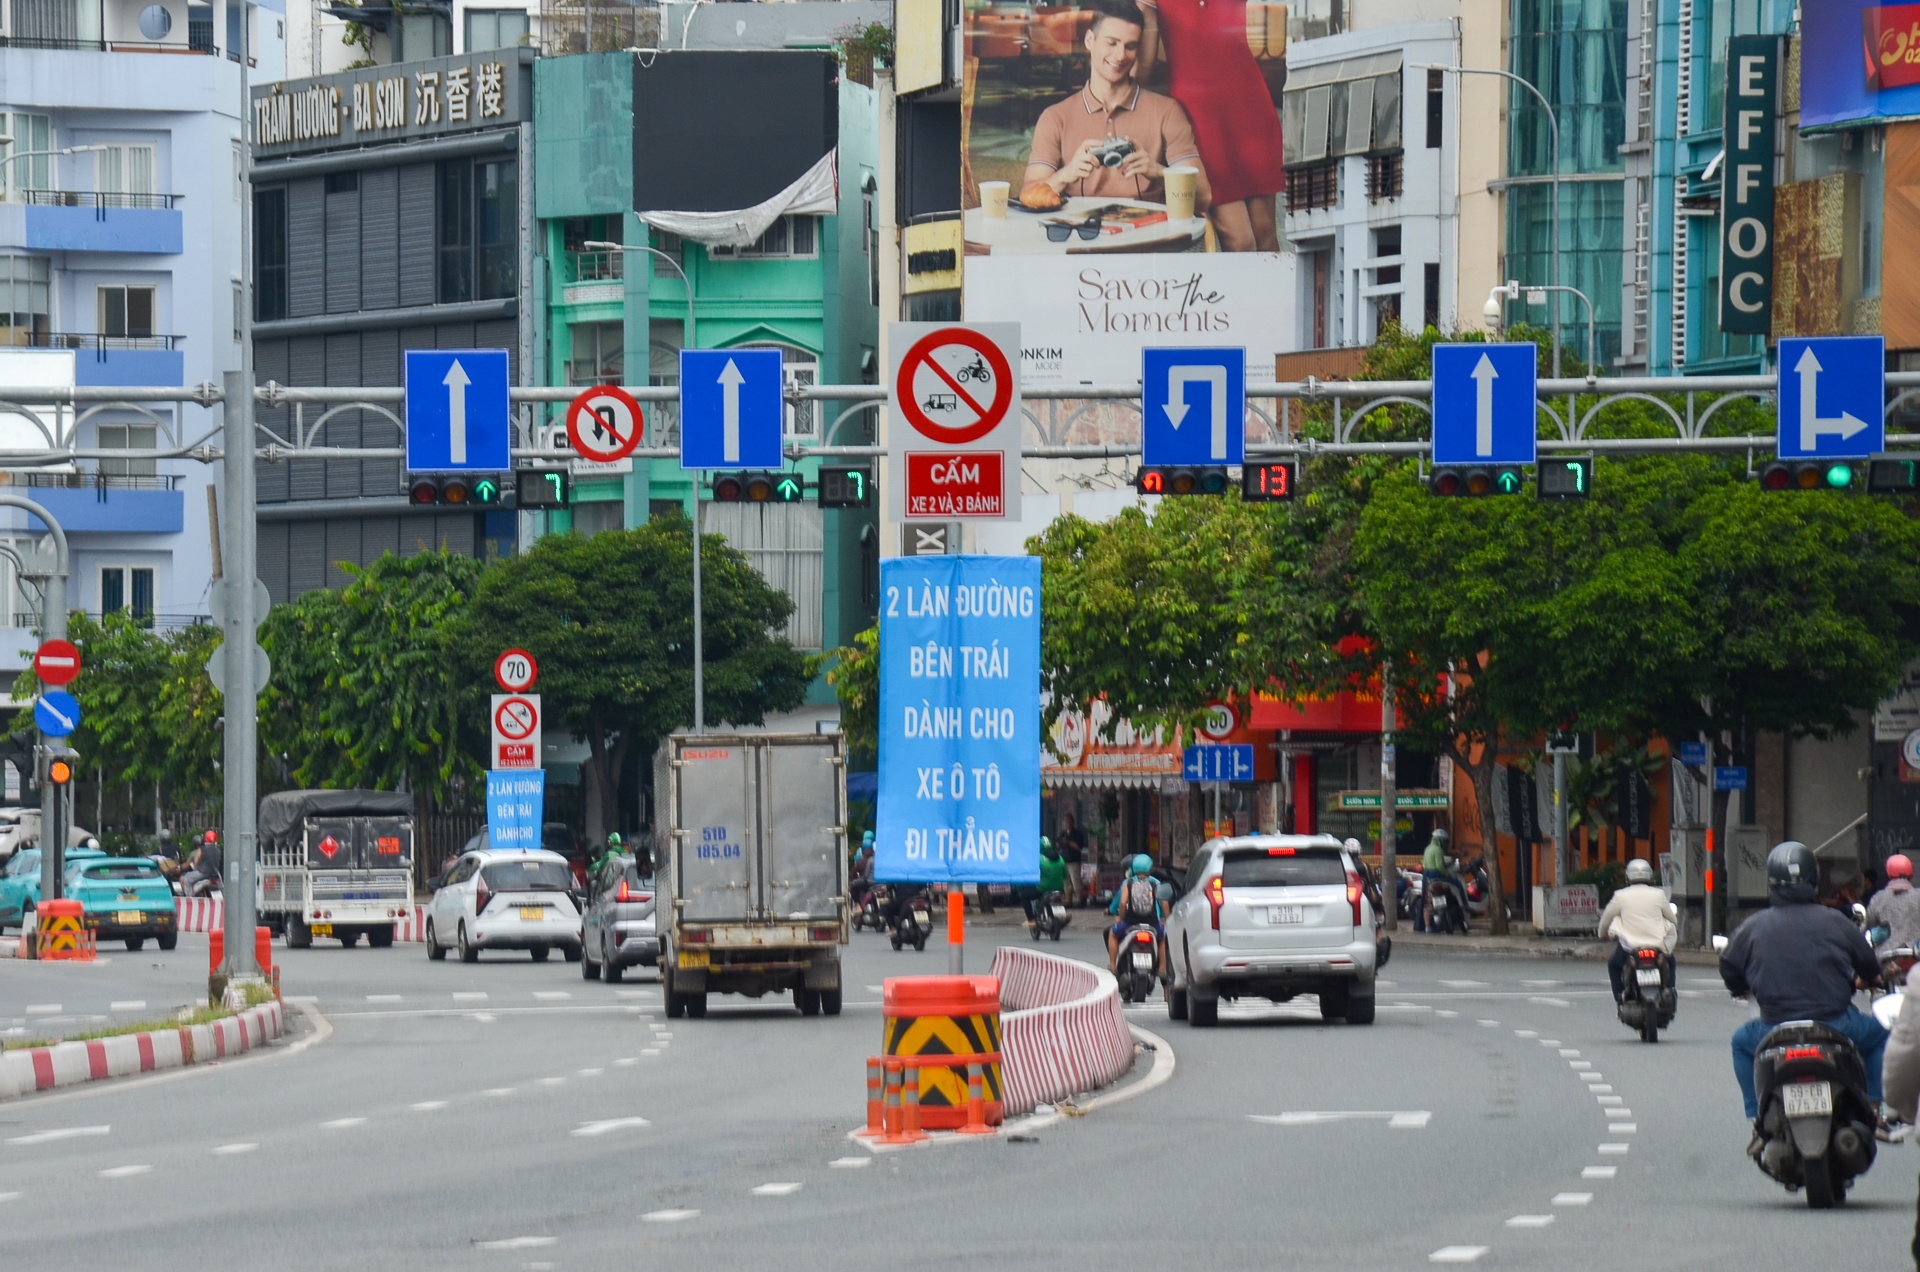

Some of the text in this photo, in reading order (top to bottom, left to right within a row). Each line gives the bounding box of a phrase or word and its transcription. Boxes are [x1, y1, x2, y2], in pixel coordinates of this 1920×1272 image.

[293, 84, 340, 139] HƯƠNG
[353, 80, 374, 132] BA
[376, 76, 407, 129] SON
[415, 62, 504, 126] 沉香楼
[1728, 55, 1767, 313] EFFOC
[1078, 268, 1226, 320] Savor the
[1077, 302, 1231, 334] Moments
[1034, 361, 1063, 371] MODE
[930, 455, 980, 485] CẤM
[1259, 465, 1288, 497] 13
[1566, 462, 1583, 492] 7
[544, 473, 562, 502] 7
[846, 471, 863, 501] 7
[911, 491, 999, 512] XE 2 VÀ 3 BÁNH
[886, 578, 1034, 618] 2 LÀN ĐƯỜNG
[507, 661, 526, 680] 70
[910, 639, 1010, 678] BÊN TRÁI
[904, 698, 1015, 740] DÀNH CHO
[683, 749, 730, 761] ISUZU
[489, 781, 495, 796] 2
[496, 778, 513, 796] LÀN
[916, 761, 1001, 800] XE Ô TÔ
[497, 802, 514, 818] BÊN
[519, 826, 534, 840] CHO
[702, 826, 727, 842] 51D
[905, 816, 1010, 861] ĐI THẲNG
[695, 843, 741, 860] 185.04
